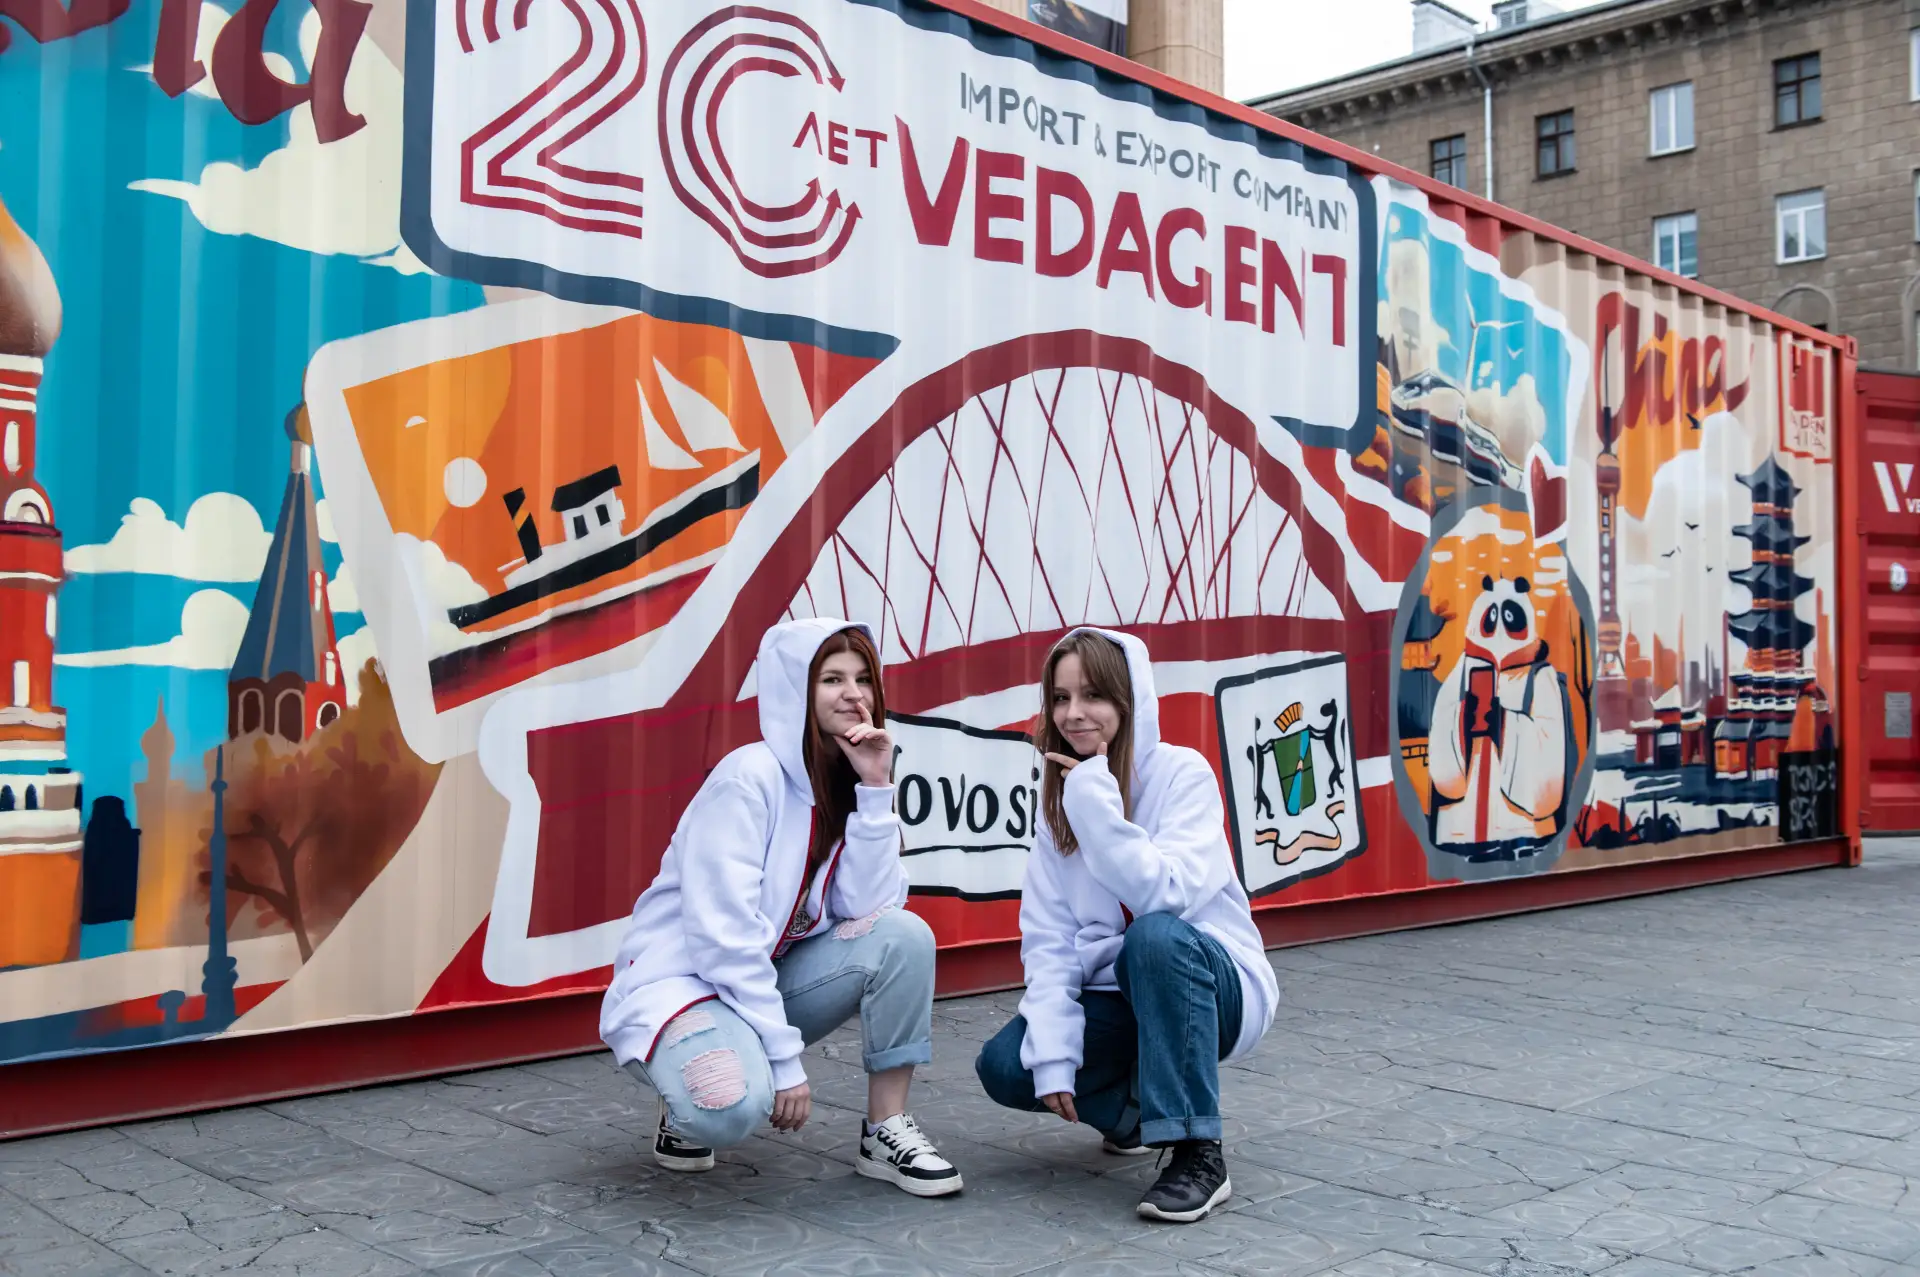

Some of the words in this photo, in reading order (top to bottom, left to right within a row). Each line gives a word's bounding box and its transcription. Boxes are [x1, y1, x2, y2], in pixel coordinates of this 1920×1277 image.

[894, 114, 1348, 349] VEDAGENT
[960, 72, 1086, 146] IMPORT
[1094, 122, 1107, 158] &
[1116, 130, 1221, 194] EXPORT
[1233, 168, 1349, 235] COMPANY
